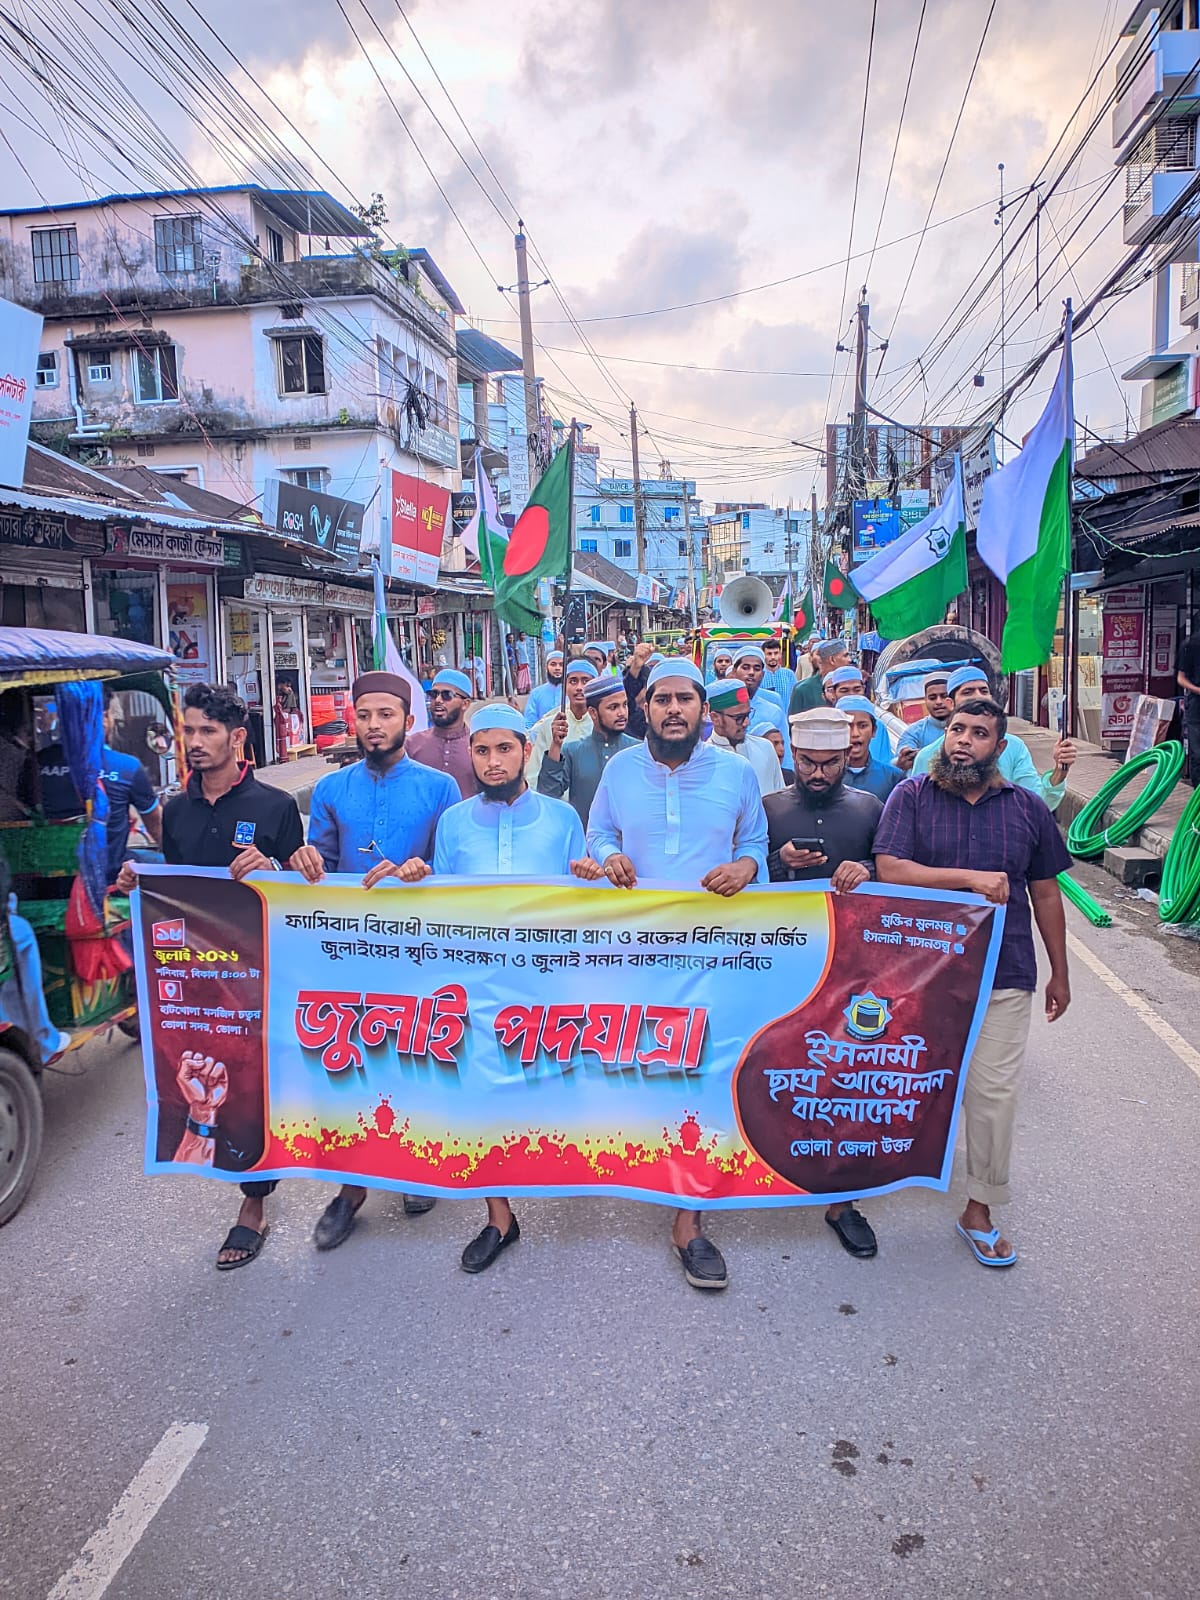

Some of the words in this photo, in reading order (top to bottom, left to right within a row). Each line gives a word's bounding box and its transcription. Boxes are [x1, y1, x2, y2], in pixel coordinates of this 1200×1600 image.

[283, 511, 304, 532] ROSA
[166, 533, 192, 552] কাজী
[285, 910, 359, 933] ফ্যাসিবাদ
[363, 914, 422, 936] বিরোধী
[426, 922, 510, 943] আন্দোলনে
[515, 927, 577, 944] হাজারো
[582, 928, 612, 946] প্রাণ
[617, 930, 631, 944] ও
[636, 930, 688, 945] রক্তের
[691, 926, 756, 947] বিনিময়ে
[760, 926, 807, 948] অর্জিত
[880, 912, 913, 928] মুক্তির
[863, 929, 903, 945] ইসলামী
[905, 936, 952, 954] শাসনতন্ত্র
[152, 947, 192, 965] জুলাই
[196, 949, 239, 962] ২০২৬
[320, 938, 400, 961] জুলাইয়ের
[404, 942, 438, 967] স্মৃতি
[442, 947, 507, 968] সংরক্ষণ
[511, 954, 526, 968] ও
[532, 950, 581, 973] জুলাই
[584, 953, 623, 968] সনদ
[627, 953, 717, 971] বাস্তবায়নের
[721, 951, 772, 971] দাবিতে
[221, 970, 247, 979] ৪:০০
[248, 967, 261, 979] টা
[202, 1006, 235, 1020] মসজিদ
[161, 1020, 187, 1031] ভোলা
[294, 983, 469, 1072] জুলাই
[493, 1003, 708, 1069] পদযাত্রা
[804, 1030, 928, 1069] ইসলামী
[763, 1069, 826, 1102] ছাত্র
[831, 1069, 954, 1097] আন্দোলন
[792, 1096, 921, 1127] বাংলাদেশ
[790, 1139, 833, 1157] ভোলা
[838, 1139, 878, 1157] জেলা
[881, 1136, 915, 1154] উত্তর
